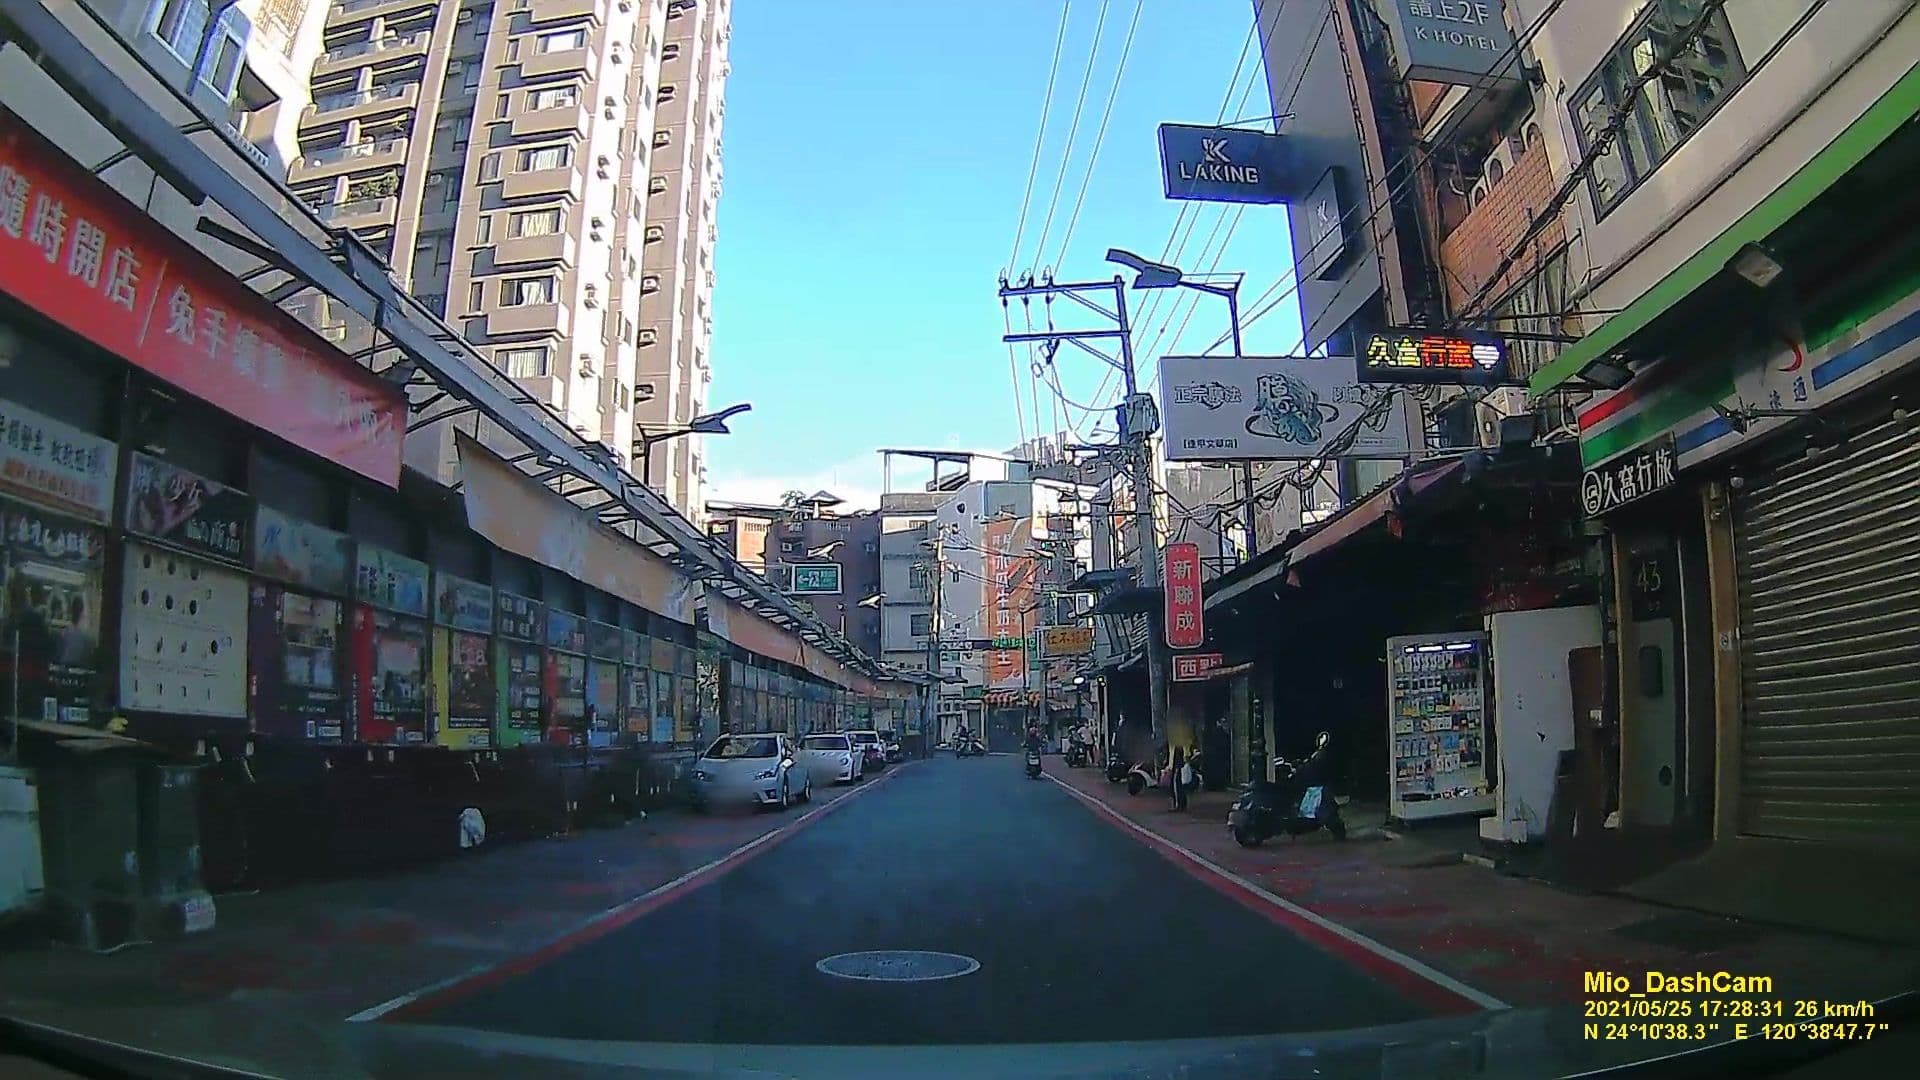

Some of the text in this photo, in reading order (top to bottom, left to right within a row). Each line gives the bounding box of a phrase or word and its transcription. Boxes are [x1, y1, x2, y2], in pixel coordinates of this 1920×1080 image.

[1414, 26, 1499, 51] K HOTEL
[1179, 161, 1258, 183] LAKING
[1604, 448, 1676, 510] 久窩行旅
[1637, 561, 1661, 593] 43
[1171, 559, 1196, 632] 新聯成
